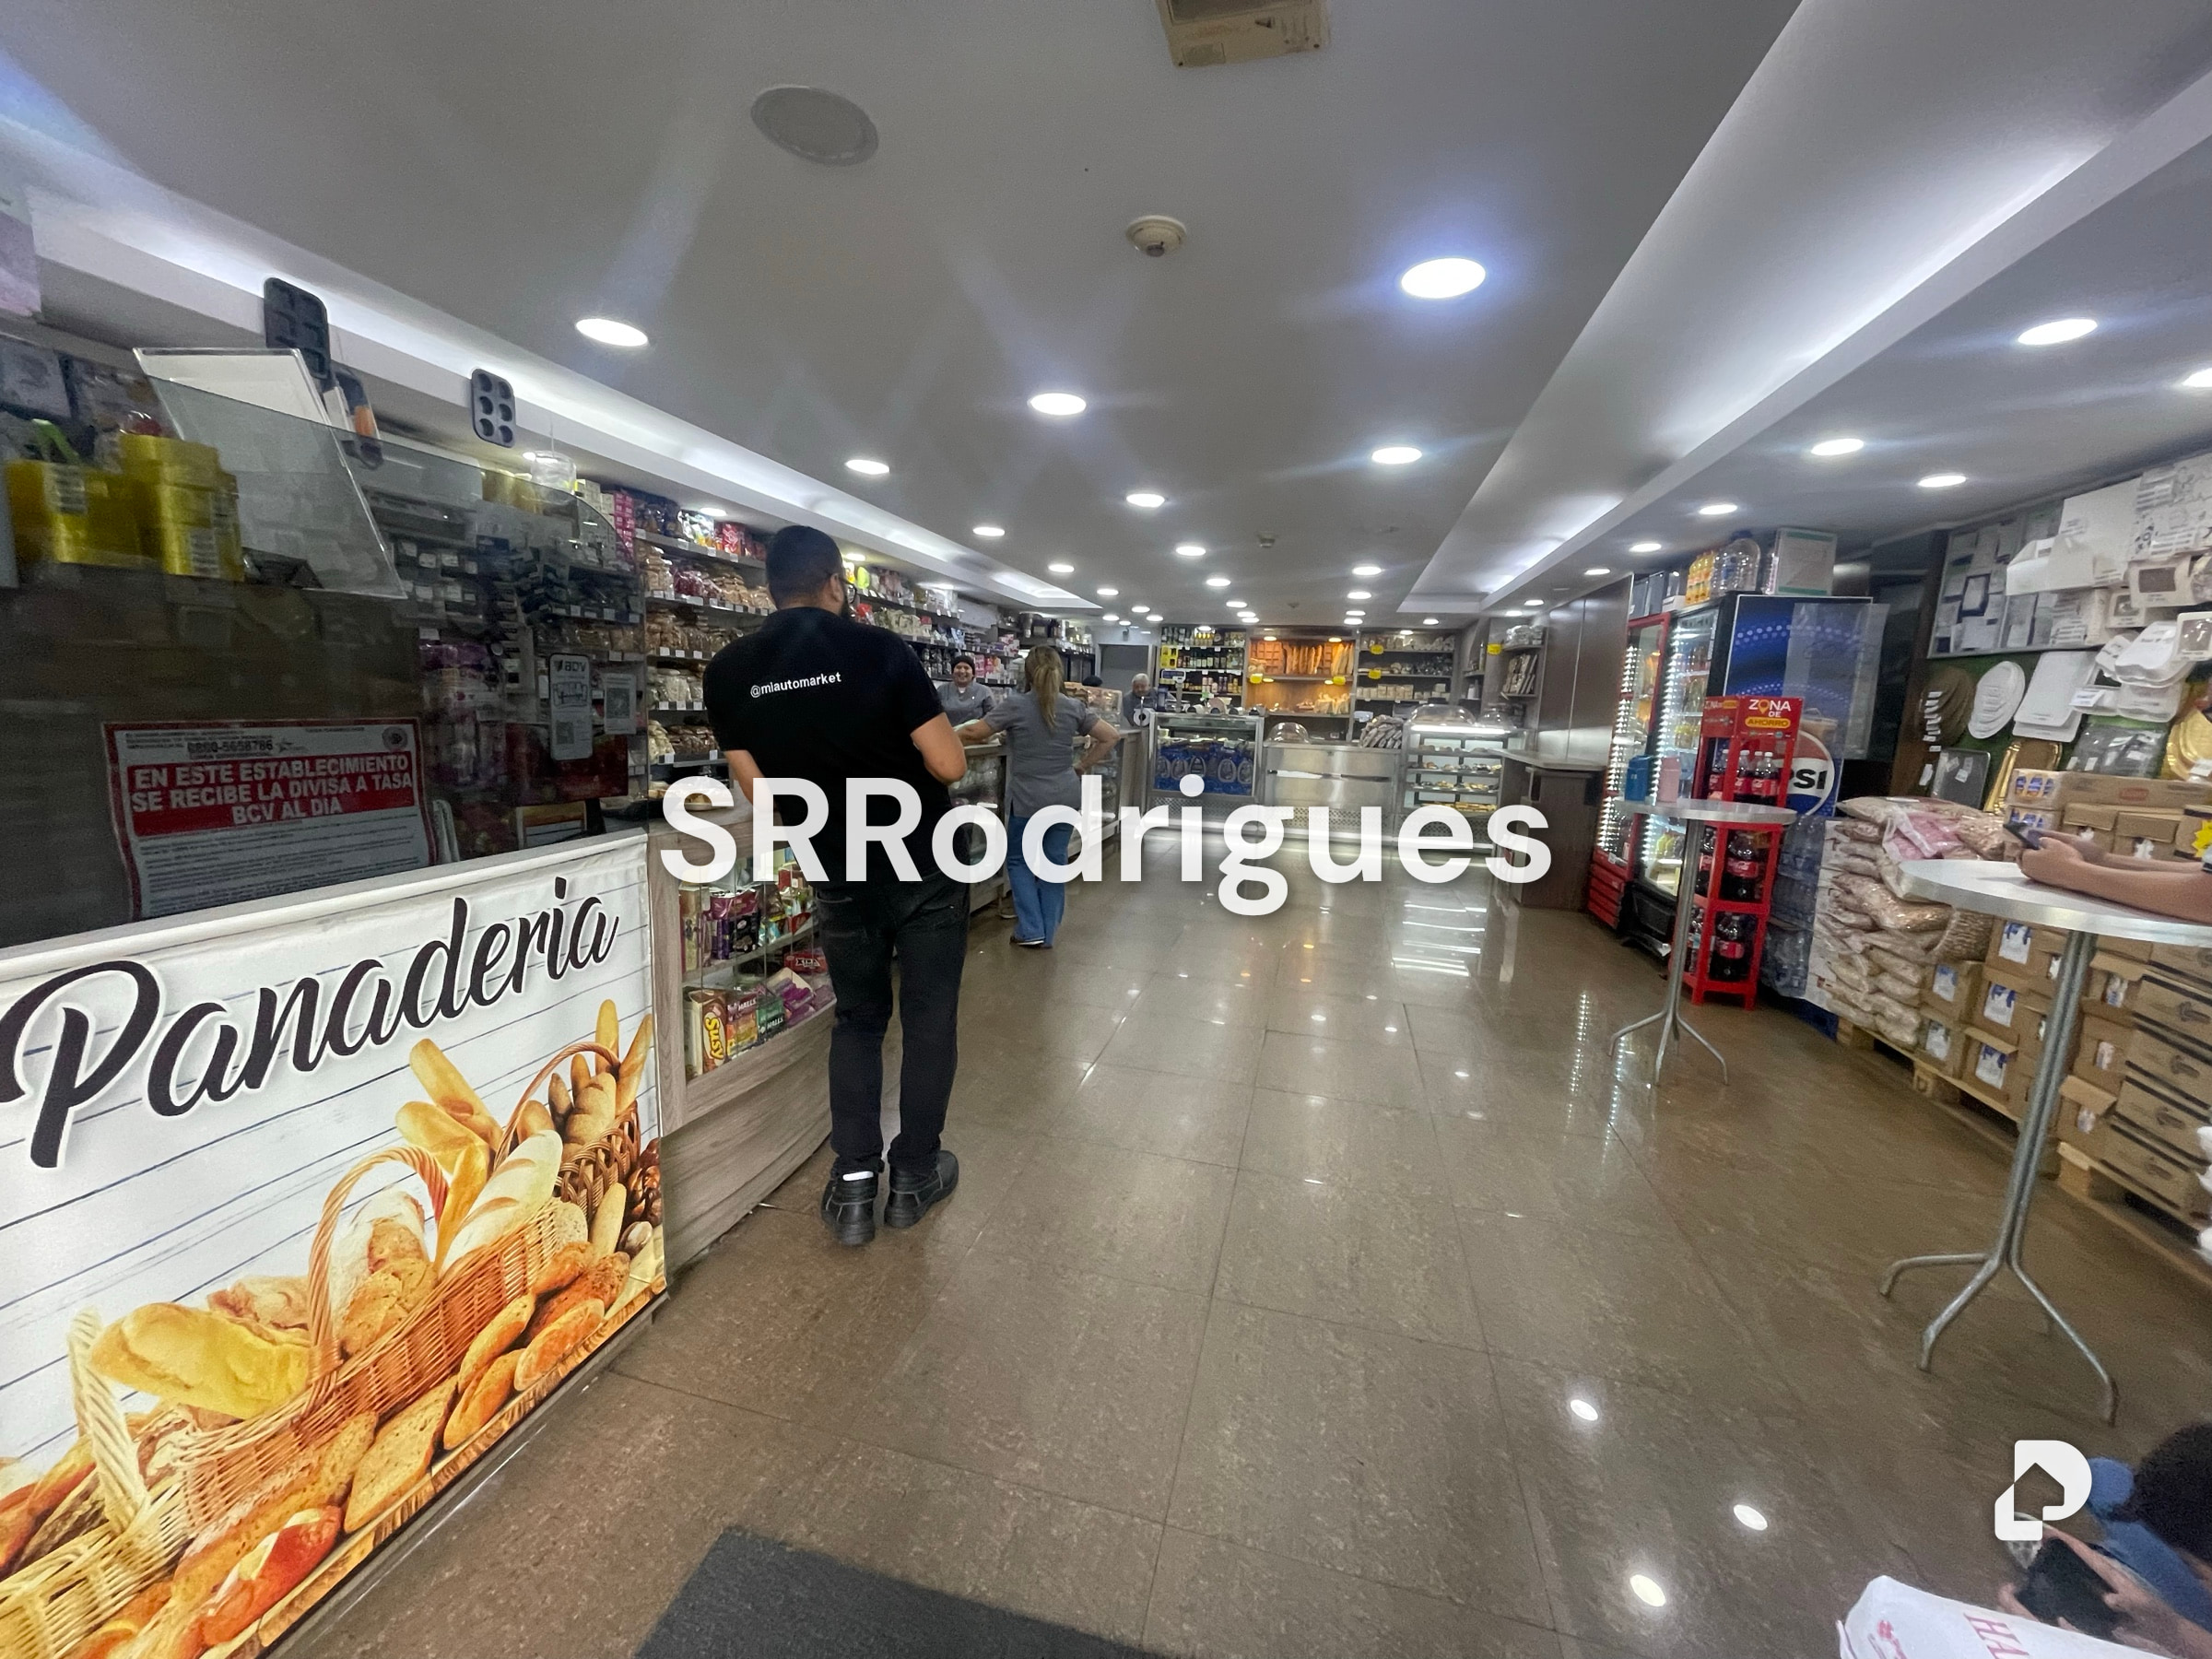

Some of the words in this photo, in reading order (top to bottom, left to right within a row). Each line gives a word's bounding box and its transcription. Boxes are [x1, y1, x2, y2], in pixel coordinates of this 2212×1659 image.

[749, 671, 842, 698] @miautomarket
[1748, 699, 1792, 712] ZONA
[1747, 718, 1789, 727] AHORRO
[135, 767, 167, 789] EN
[176, 764, 234, 786] ESTE
[240, 755, 409, 782] ESTABLECIMIENTO
[131, 791, 163, 813] SE
[171, 784, 253, 809] RECIBE
[258, 781, 285, 802] LA
[289, 776, 351, 796] DIVISA
[356, 774, 370, 793] A
[371, 771, 413, 791] TASA
[232, 802, 276, 825] BCV
[281, 800, 306, 820] AL
[704, 1017, 725, 1060] Susy
